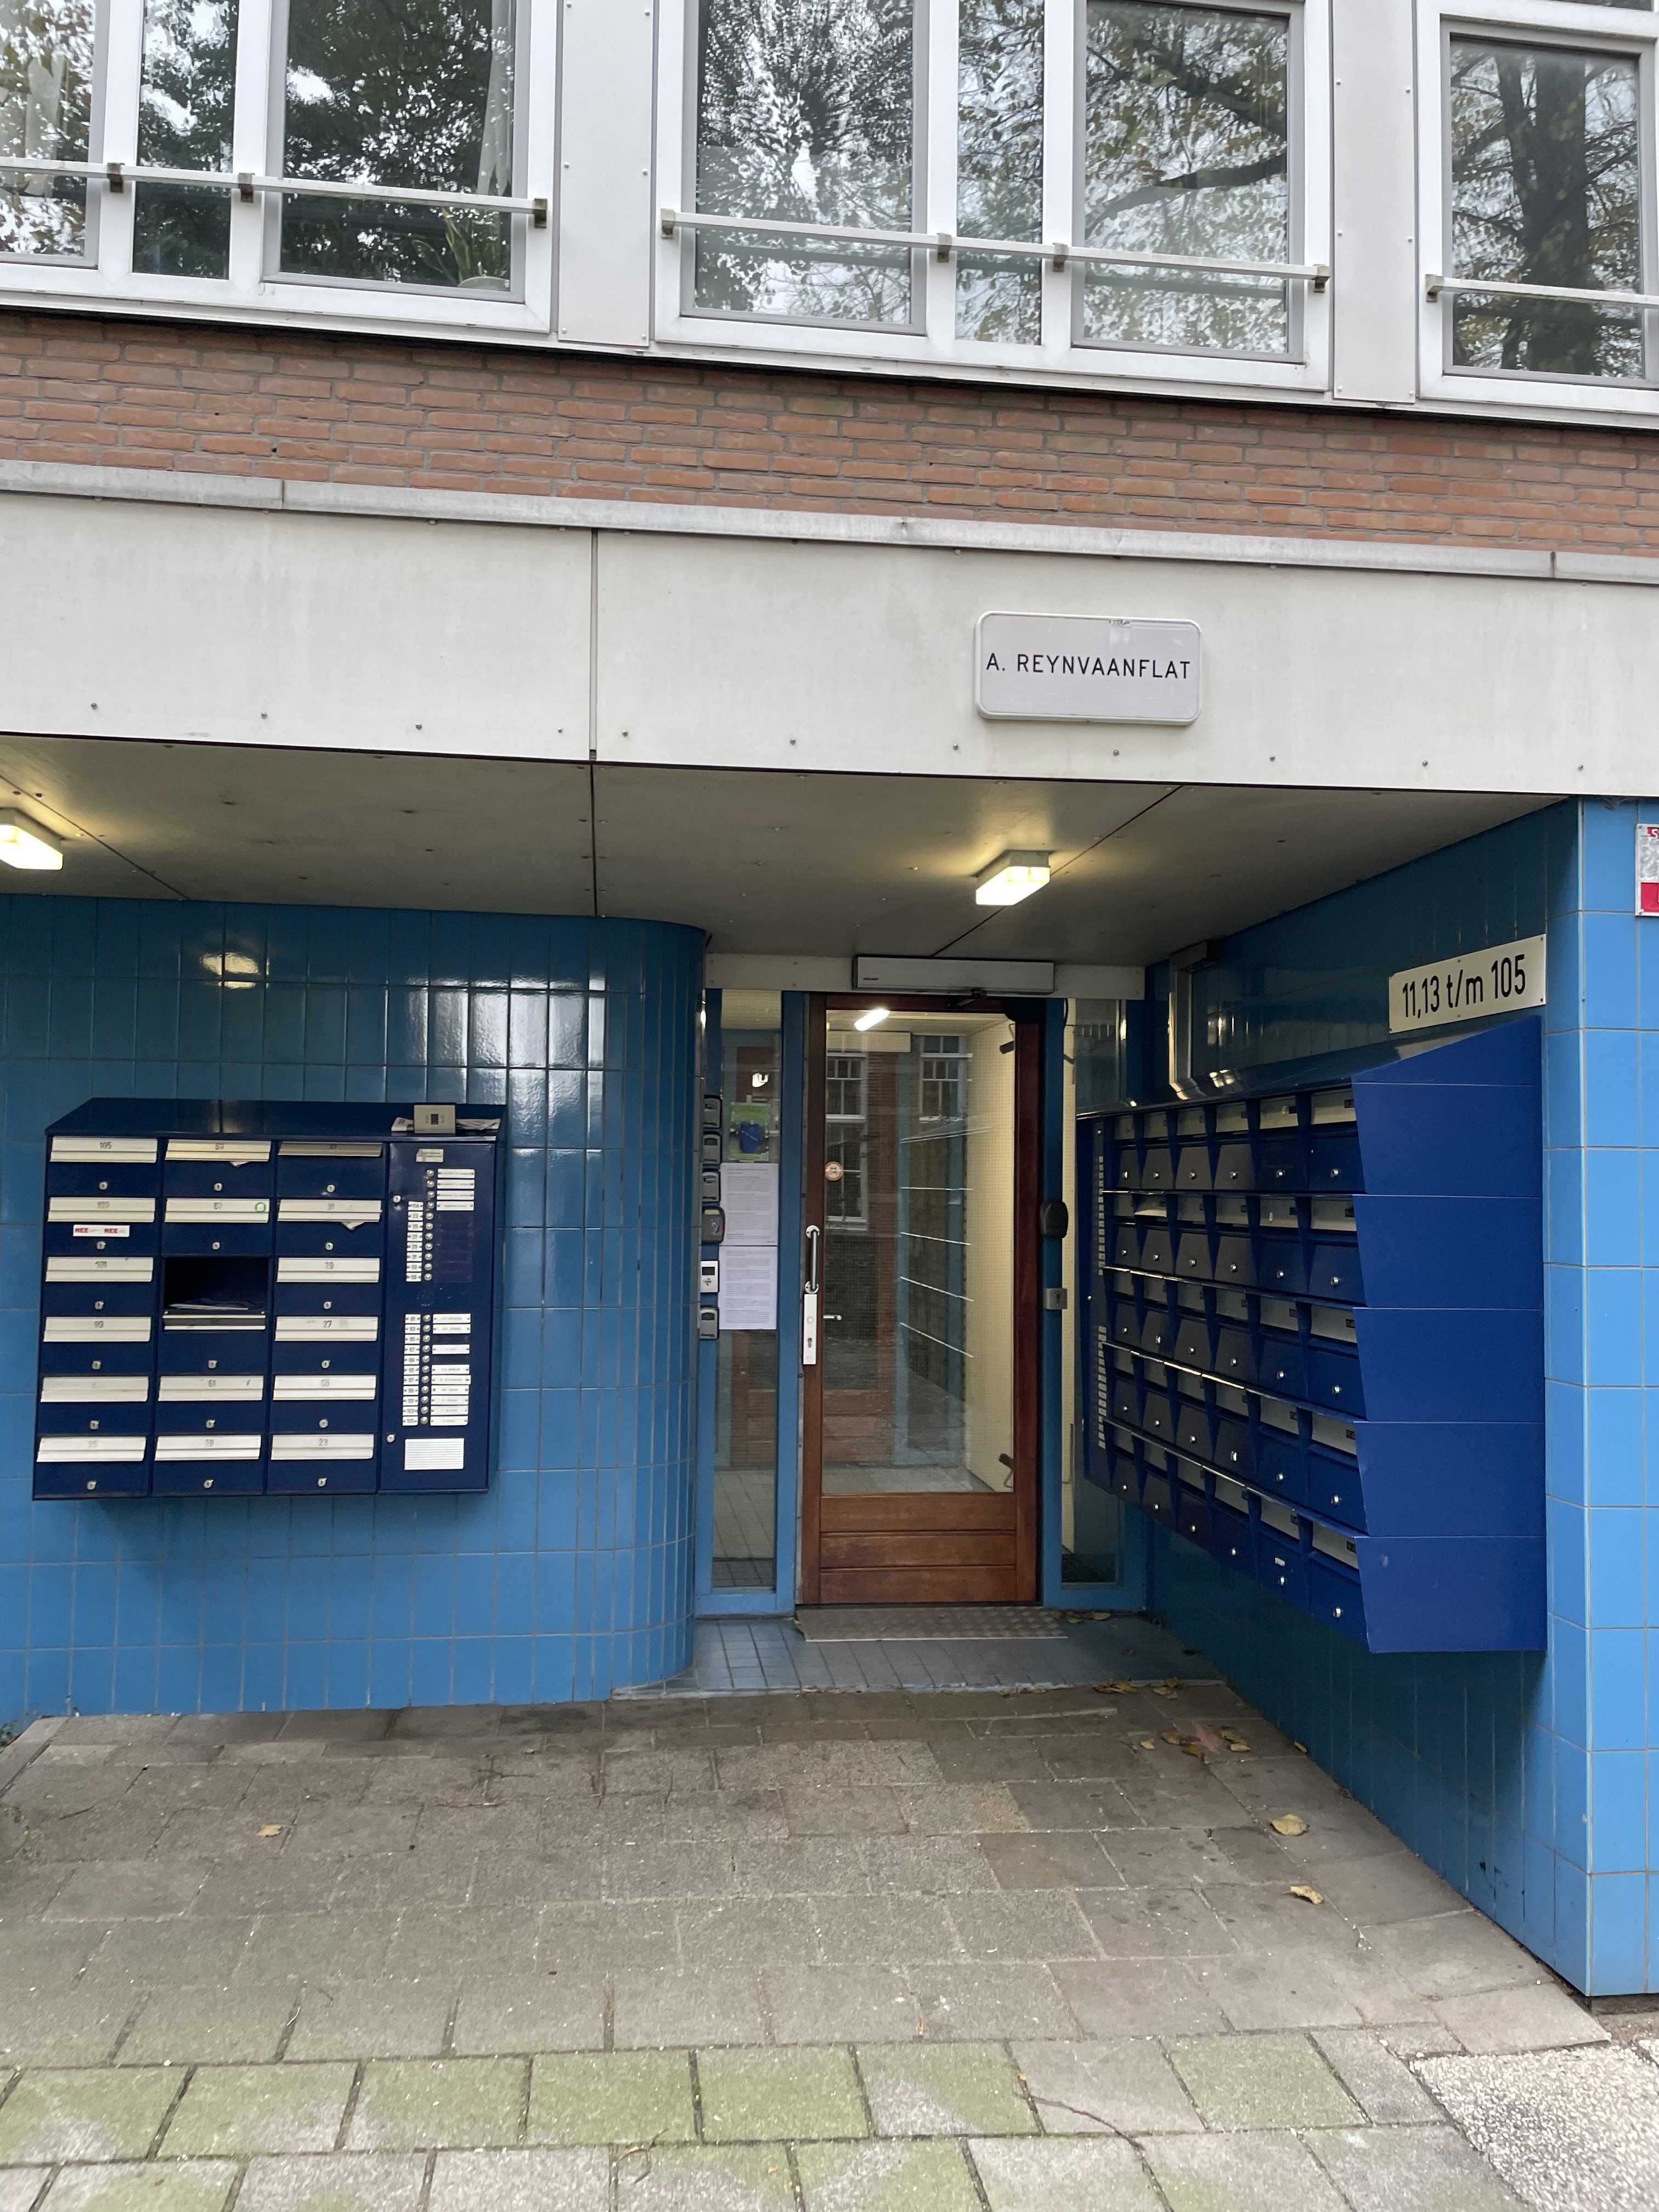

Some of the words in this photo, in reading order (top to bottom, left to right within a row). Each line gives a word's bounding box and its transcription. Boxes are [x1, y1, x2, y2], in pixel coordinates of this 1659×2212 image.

[986, 652, 1006, 672] A.
[1017, 653, 1190, 679] REYNVAANFLAT
[1402, 975, 1440, 1018] 11,13
[1446, 969, 1483, 1008] t/m
[1491, 953, 1526, 999] 105
[323, 1320, 332, 1328] 27
